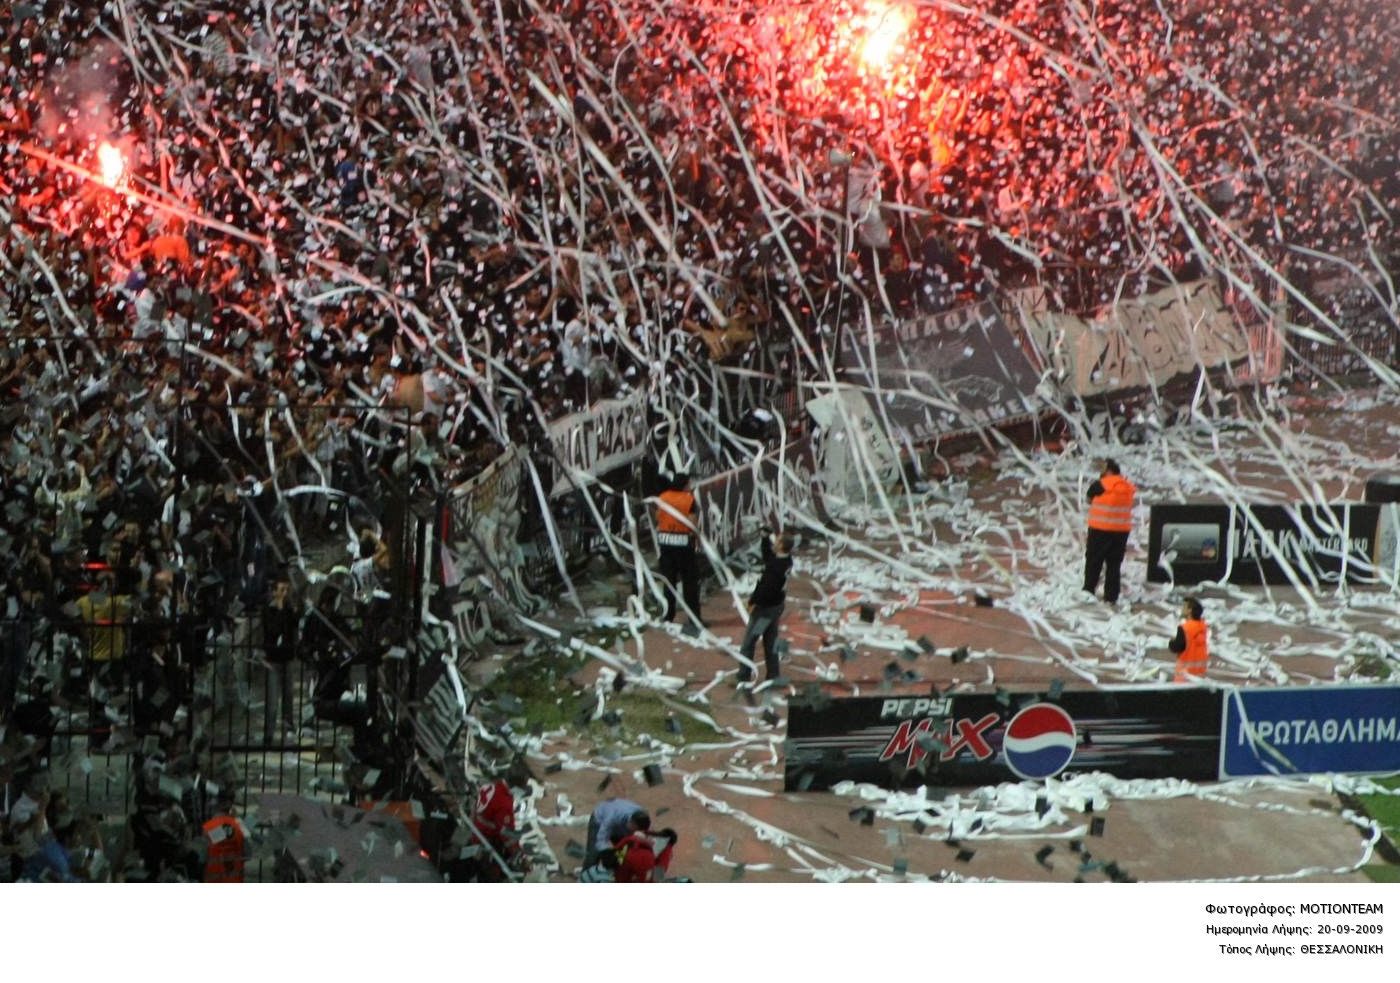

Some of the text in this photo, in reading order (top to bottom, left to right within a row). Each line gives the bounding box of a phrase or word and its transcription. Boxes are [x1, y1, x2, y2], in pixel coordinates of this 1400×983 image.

[1299, 536, 1369, 552] MATERARD
[880, 698, 953, 717] PEPSI
[1238, 717, 1400, 746] ΠΡΩΤΑΘΛΗΜ
